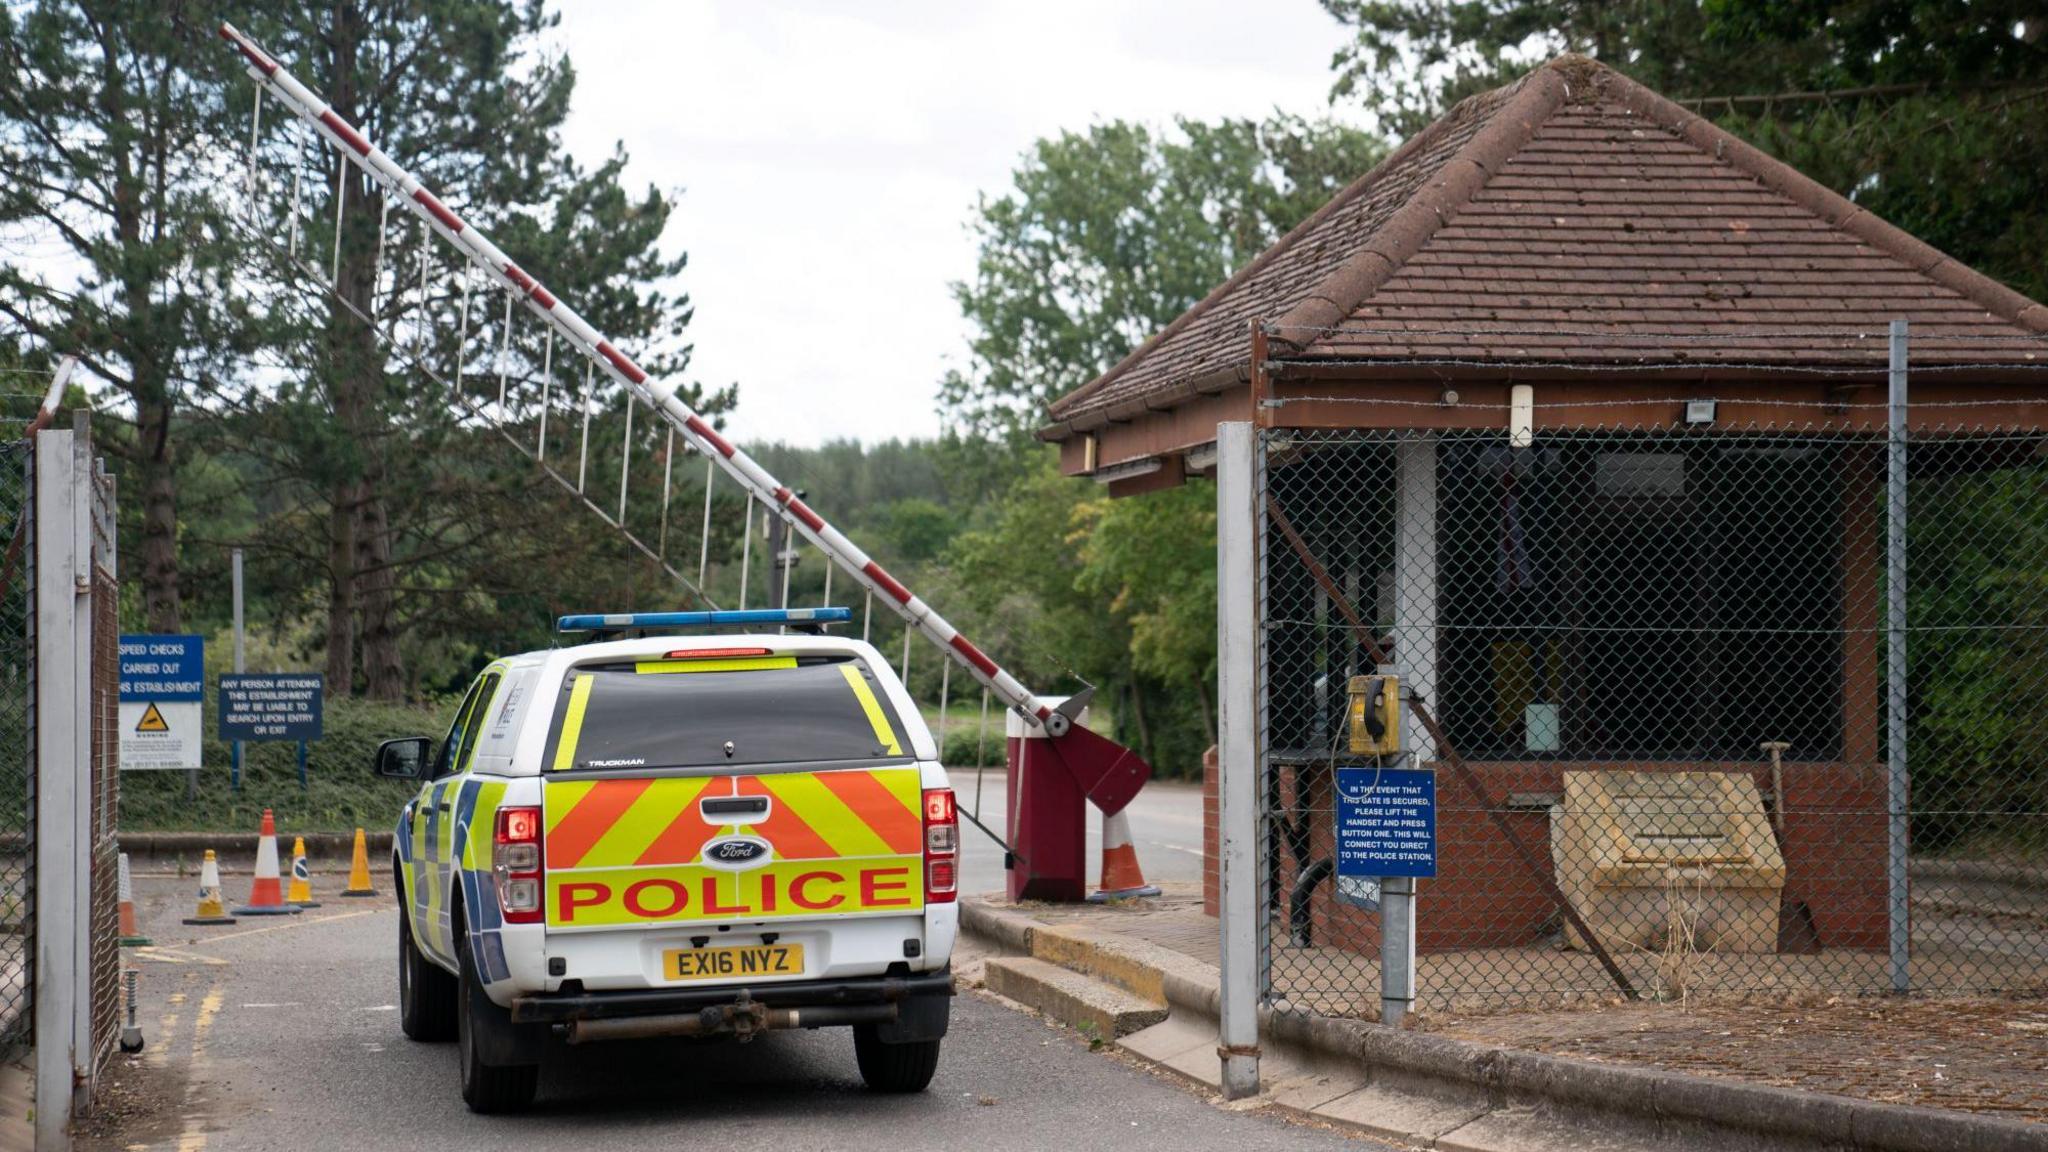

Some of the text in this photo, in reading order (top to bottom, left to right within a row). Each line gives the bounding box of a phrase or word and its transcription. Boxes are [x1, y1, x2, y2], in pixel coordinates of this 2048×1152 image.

[149, 644, 184, 656] CHECKS
[122, 662, 180, 674] CARRIED OUT
[134, 682, 201, 693] ESTABLISHMENT
[221, 680, 320, 688] ANY PERSON ATTENDING
[228, 691, 313, 700] THIS ESTABLISHMENT
[233, 702, 308, 711] MAY BE LIABLE TO
[226, 714, 314, 723] SEARCH UPON ENTRY
[254, 726, 288, 734] OR EXIT
[588, 758, 645, 767] TRUCKMAN
[720, 842, 754, 857] Ford
[558, 868, 911, 922] POLICE
[678, 948, 790, 977] EX16 NYZ
